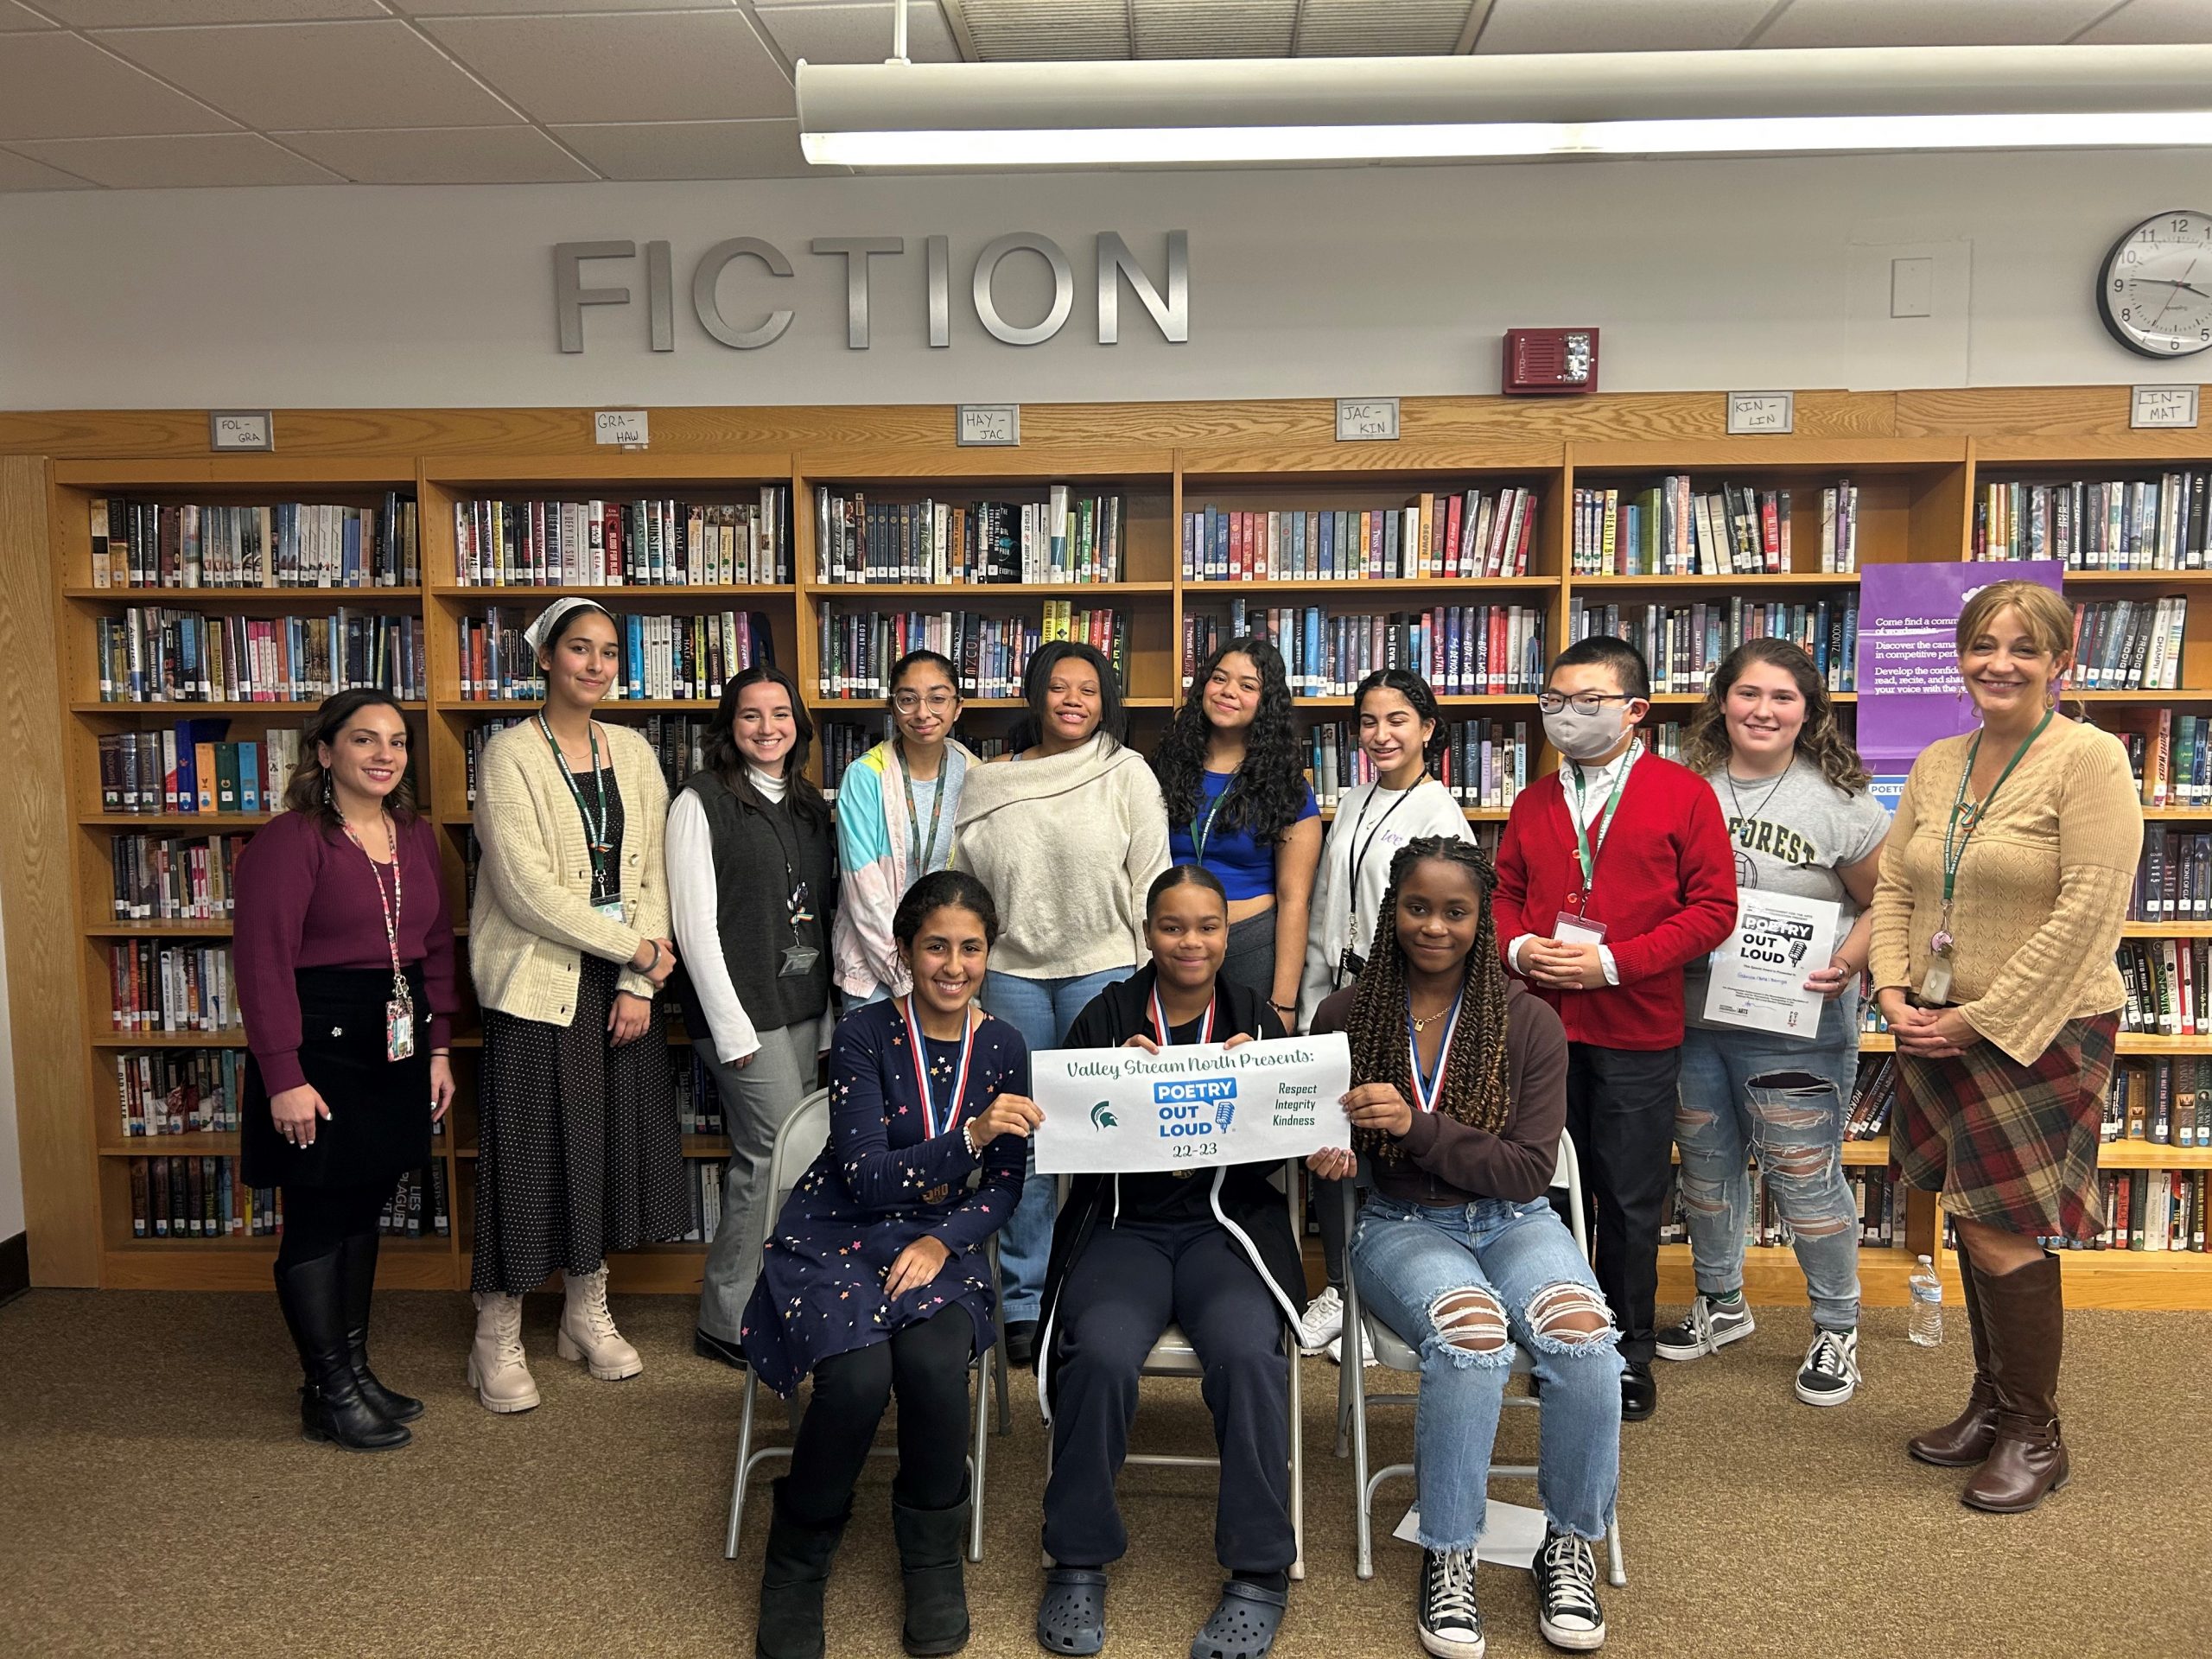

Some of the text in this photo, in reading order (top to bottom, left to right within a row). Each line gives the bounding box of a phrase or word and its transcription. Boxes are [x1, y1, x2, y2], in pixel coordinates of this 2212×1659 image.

[2171, 219, 2188, 232] 12
[2141, 230, 2155, 242] 11
[2121, 251, 2135, 264] 10
[556, 229, 1188, 353] FICTION
[2114, 279, 2123, 292] 9
[2122, 308, 2130, 321] 8
[2142, 330, 2150, 343] 7
[2201, 328, 2209, 341] 5
[2171, 337, 2179, 350] 6
[1749, 415, 1774, 425] LIN
[2150, 406, 2180, 420] MAT
[980, 429, 1004, 440] JAC
[1360, 423, 1384, 434] KIN
[243, 433, 260, 442] GRA
[617, 431, 639, 442] HAW
[979, 506, 985, 523] WE
[1605, 514, 1615, 547] REALITY
[548, 514, 559, 568] DEFY THE FATE
[565, 517, 575, 568] DEFY THE STAR
[1831, 625, 1840, 652] KOONTZ
[1465, 641, 1473, 656] BOX
[1885, 651, 1936, 659] competitive
[1939, 651, 1958, 659] perf
[2158, 733, 2168, 781] DEEPER WATERS
[1728, 817, 1815, 864] FOREST
[1745, 918, 1809, 938] POETRY
[1743, 934, 1777, 948] OUT
[1740, 948, 1785, 964] LOUD
[1067, 1049, 1313, 1080] Valley Stream North Presents:
[1159, 1082, 1231, 1099] POETRY
[1279, 1083, 1317, 1095] Respect
[118, 1090, 127, 1119] YELLER
[1275, 1100, 1315, 1111] Integrity
[1160, 1106, 1198, 1119] OUT
[1273, 1116, 1315, 1127] Kindness
[1160, 1123, 1211, 1137] LOUD
[1173, 1143, 1217, 1158] 22-23
[410, 1185, 422, 1211] LIES
